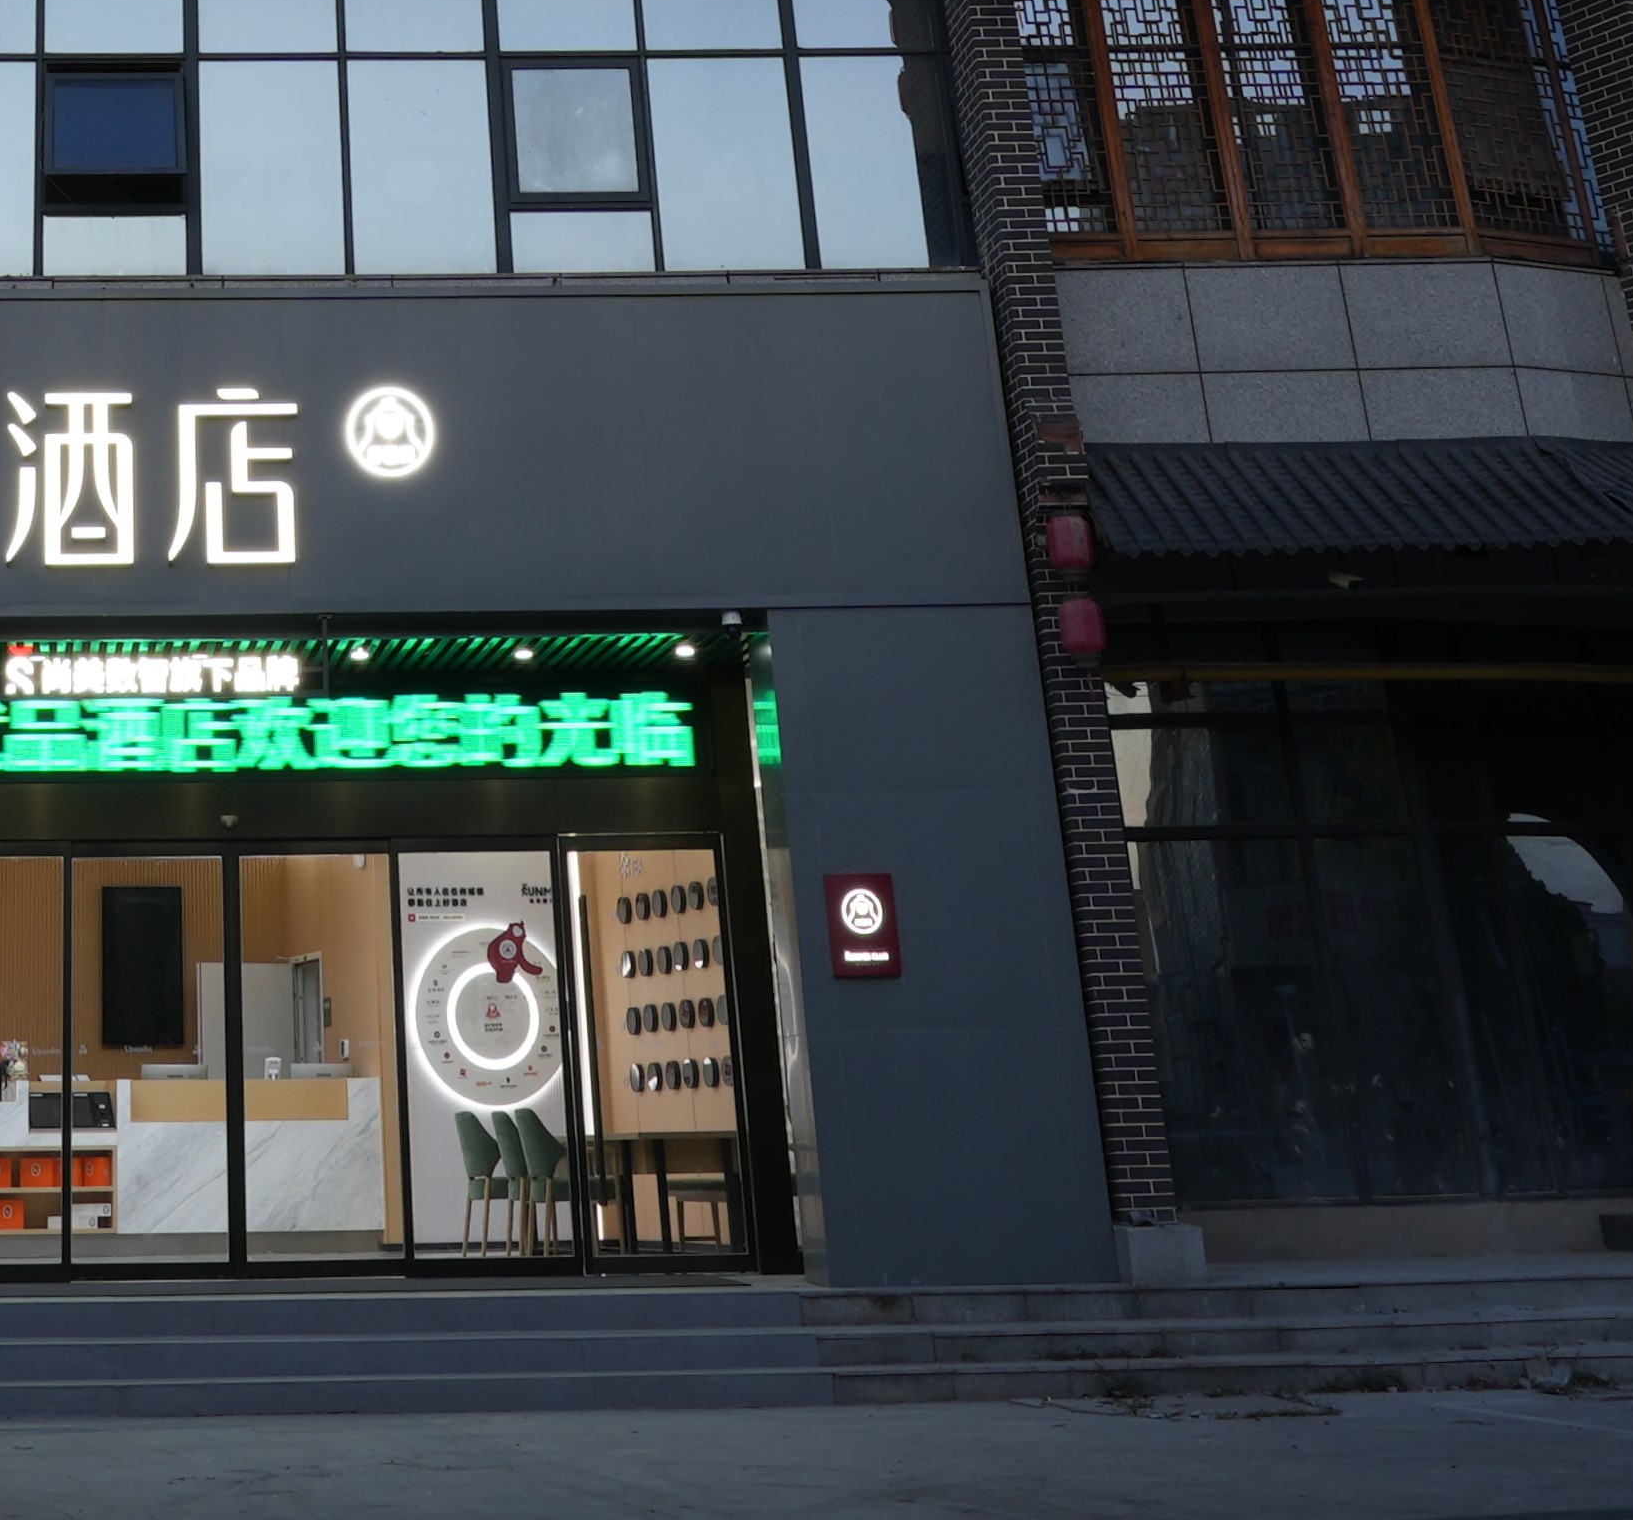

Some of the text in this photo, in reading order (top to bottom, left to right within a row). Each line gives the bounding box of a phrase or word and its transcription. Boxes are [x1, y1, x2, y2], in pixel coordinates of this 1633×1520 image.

[40, 655, 301, 694] 尚美数智旗下品牌
